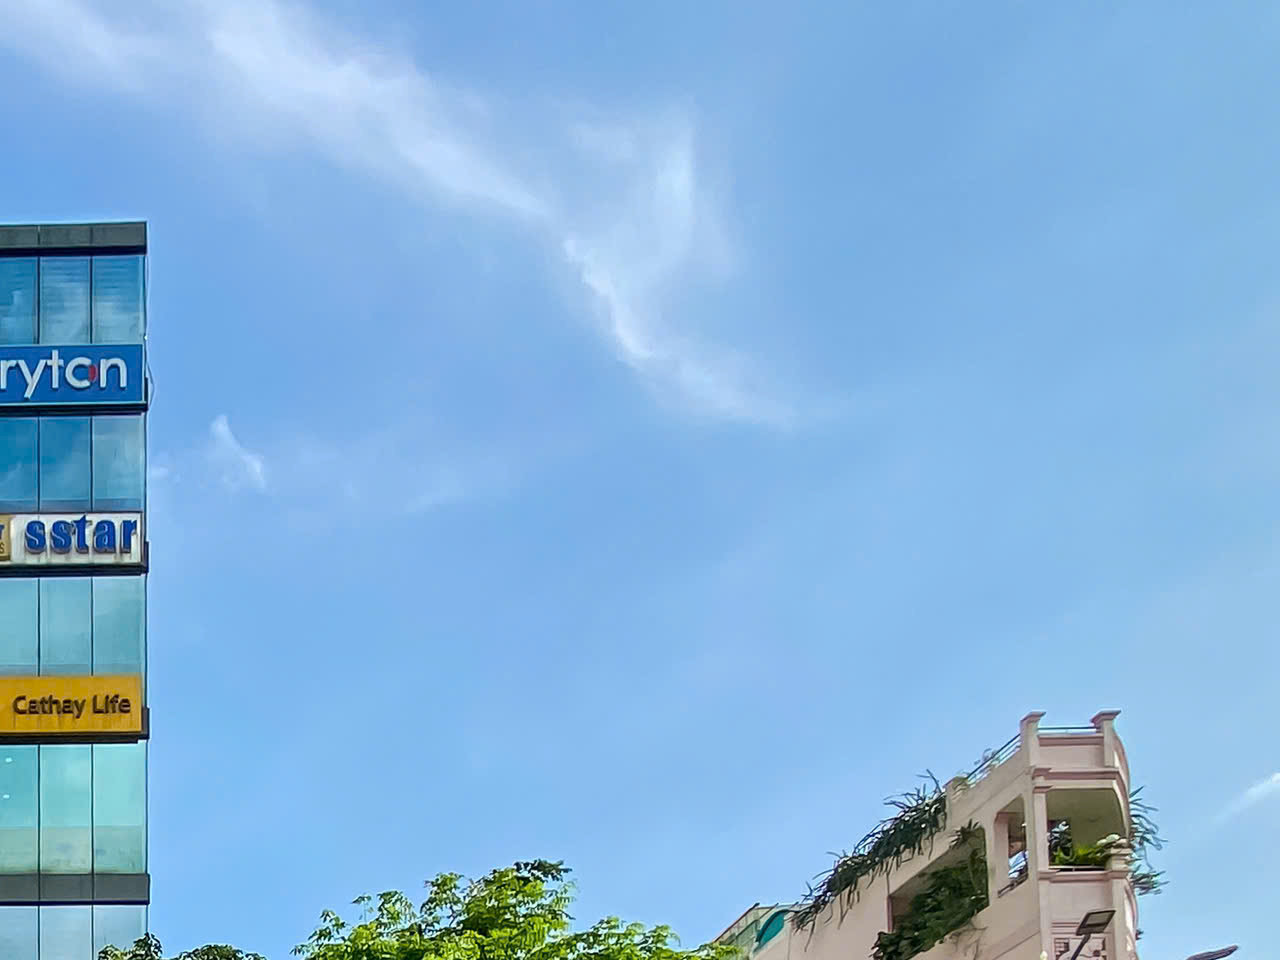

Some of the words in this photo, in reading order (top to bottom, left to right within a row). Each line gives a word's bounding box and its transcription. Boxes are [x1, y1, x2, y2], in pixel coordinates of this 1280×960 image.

[24, 514, 138, 554] sstar
[13, 694, 86, 719] Cathay
[92, 694, 132, 715] Life
